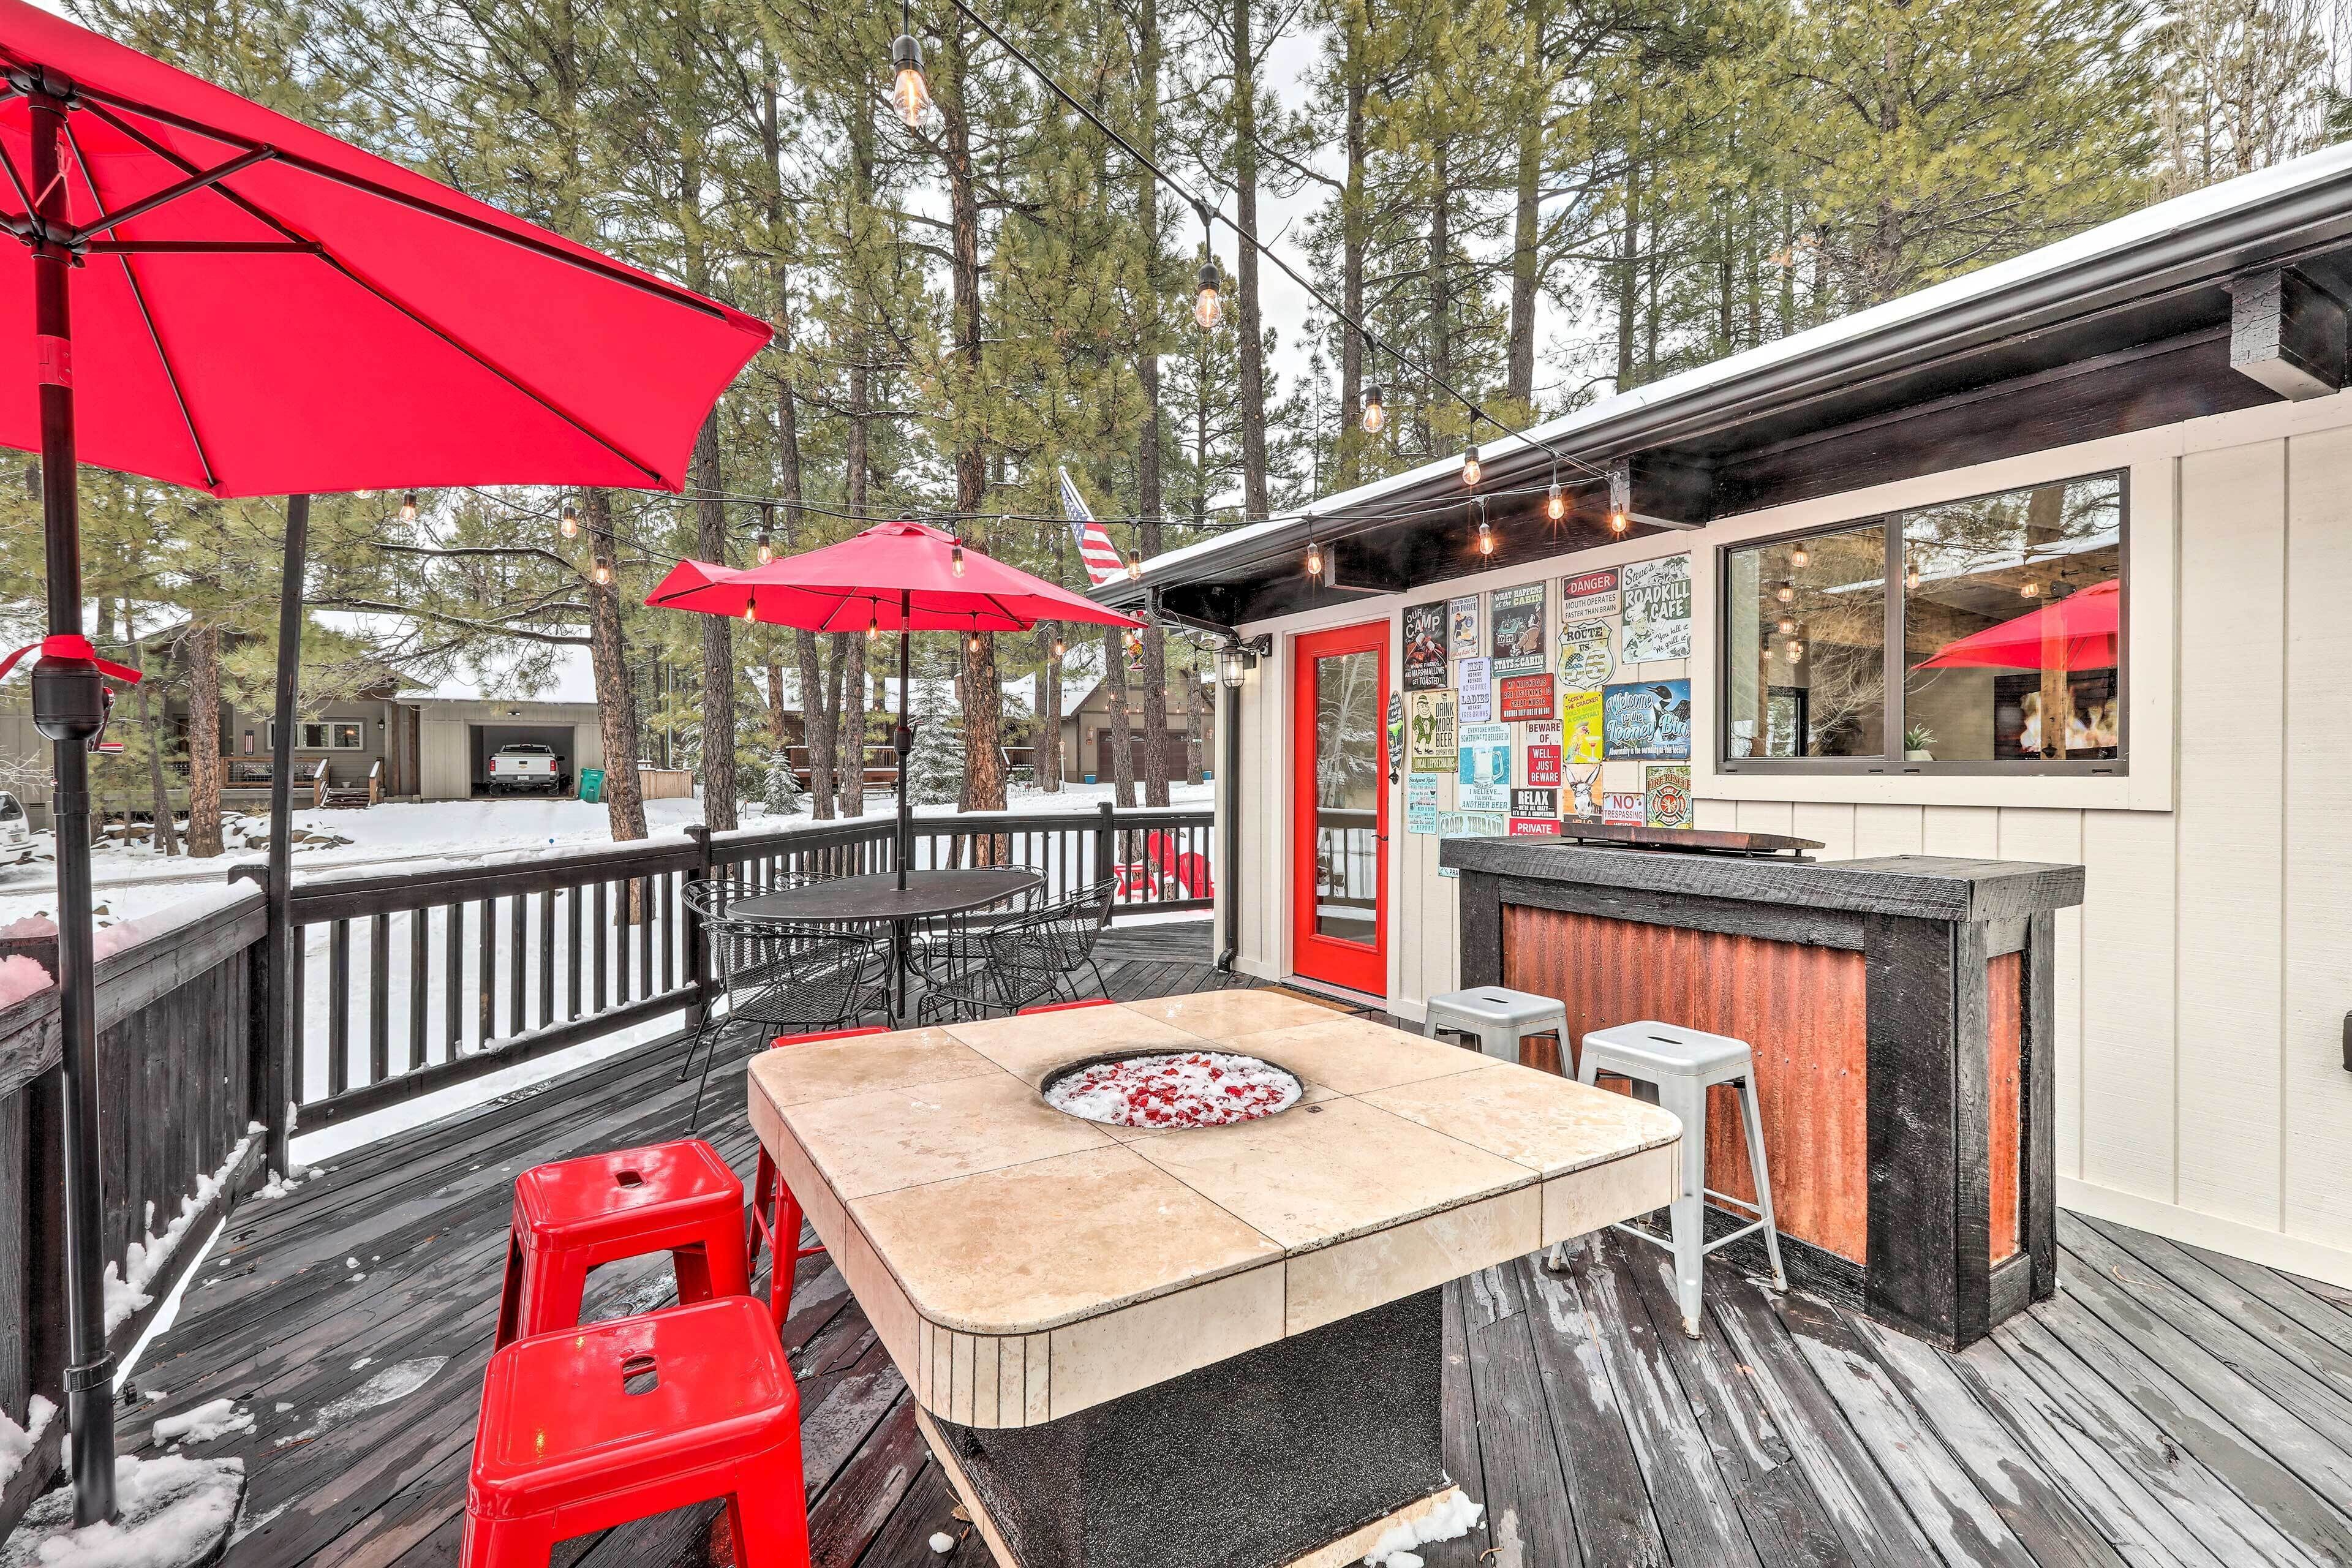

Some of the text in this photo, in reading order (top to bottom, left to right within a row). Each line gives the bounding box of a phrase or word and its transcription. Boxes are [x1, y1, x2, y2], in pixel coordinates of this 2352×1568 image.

[1625, 563, 1656, 585] Steve's
[1570, 576, 1610, 594] DANGER
[1494, 586, 1544, 601] WHAT HAPPENS
[1625, 581, 1691, 607] ROADKILL
[1513, 594, 1544, 606] CABIN
[1566, 594, 1616, 609] MOUTH OPERATES
[1452, 602, 1477, 614] AIR FORCE
[1651, 600, 1684, 620] CAFE
[1407, 609, 1422, 623] OUR
[1566, 610, 1583, 619] FASTER
[1406, 614, 1440, 638] CAMP
[1670, 624, 1682, 635] kill
[1567, 627, 1602, 641] ROUTE
[1653, 645, 1665, 654] We
[1665, 635, 1679, 649] grill
[1494, 659, 1513, 671] STAYS
[1520, 655, 1544, 667] CABIN
[1565, 653, 1605, 682] 66
[1412, 666, 1444, 677] MARSHMALLOWS
[1420, 676, 1439, 685] TOASTED
[1516, 677, 1547, 688] NEIGHBORS
[1515, 688, 1542, 698] LISTENING
[1544, 687, 1551, 696] TO
[1568, 694, 1584, 703] SCREW
[1461, 694, 1490, 704] LADIES
[1510, 699, 1526, 707] GREAT
[1576, 696, 1598, 707] CRACKER
[1606, 692, 1653, 717] Welcome
[1436, 701, 1454, 717] DRINK
[1621, 710, 1643, 725] to the
[1436, 717, 1454, 732] MORE
[1529, 723, 1560, 733] BEWARE
[1607, 713, 1690, 746] Looney Bin
[1436, 733, 1454, 747] BEER.
[1540, 734, 1549, 743] OF
[1532, 748, 1559, 759] WELL...
[1608, 746, 1630, 756] Abnormality
[1642, 744, 1659, 756] normality
[1673, 744, 1687, 755] locality
[1415, 758, 1455, 769] LOCAL LEPRECHAUNS
[1536, 761, 1553, 771] JUST
[1531, 772, 1559, 782] BEWARE
[1518, 791, 1549, 805] RELAX
[1614, 796, 1634, 809] NO
[1604, 810, 1643, 820] TRESPASSING
[1441, 816, 1501, 838] GROUP THERAPY
[1517, 823, 1553, 834] PRIVATE
